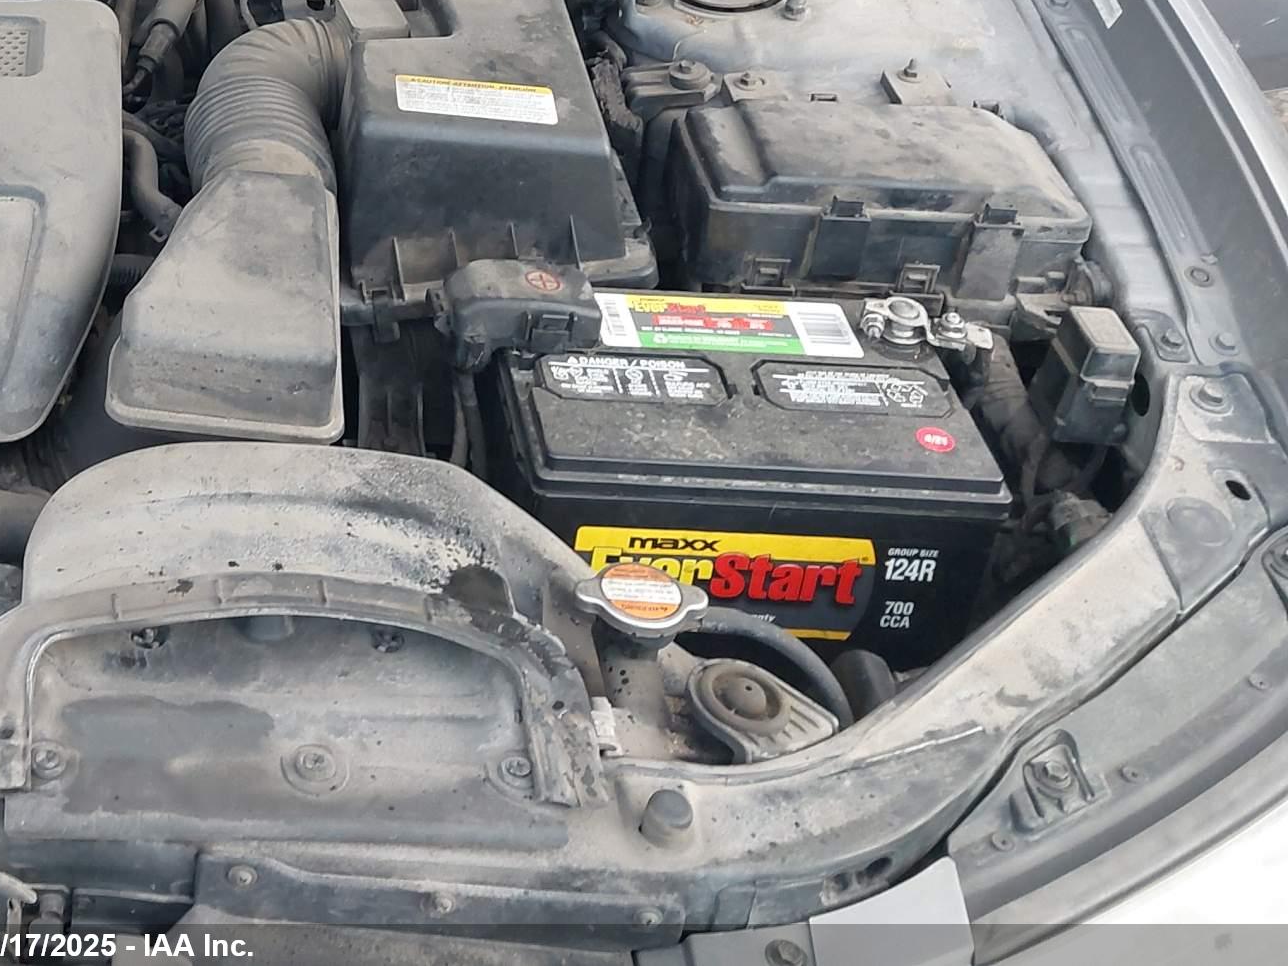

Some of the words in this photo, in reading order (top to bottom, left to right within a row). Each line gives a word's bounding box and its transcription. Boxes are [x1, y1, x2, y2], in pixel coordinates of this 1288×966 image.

[579, 356, 628, 368] DANGER
[639, 359, 686, 369] POISON
[887, 547, 919, 557] GROUP
[919, 549, 939, 558] SIZE
[591, 545, 862, 605] EerStart
[884, 557, 937, 582] 124R
[884, 600, 915, 616] 700
[879, 615, 911, 629] CCA
